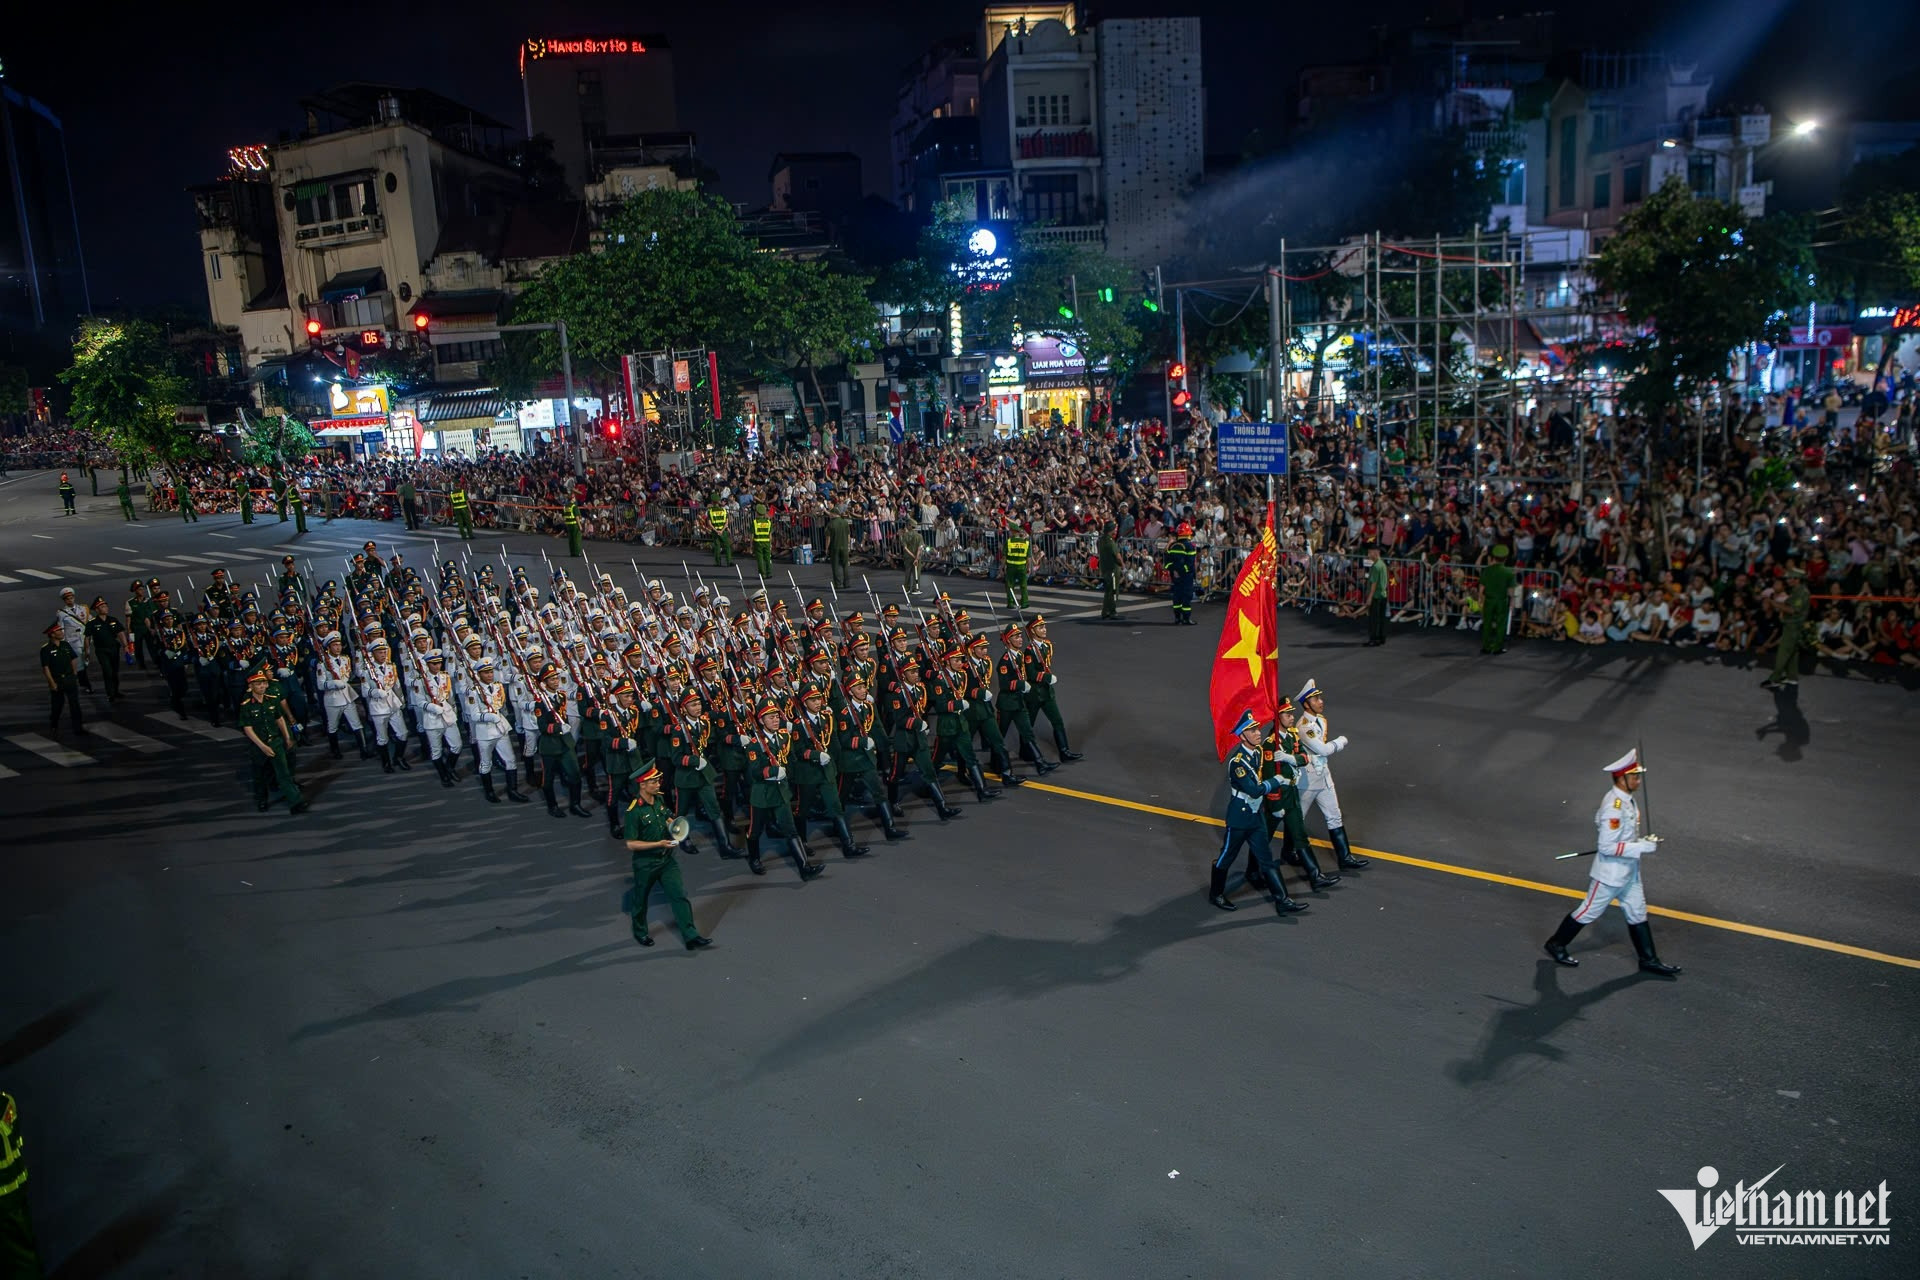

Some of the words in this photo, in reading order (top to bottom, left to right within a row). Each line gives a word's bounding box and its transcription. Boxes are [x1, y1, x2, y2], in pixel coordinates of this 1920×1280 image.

[548, 40, 582, 53] HANOI
[609, 39, 646, 53] HOEL
[364, 332, 378, 344] 06
